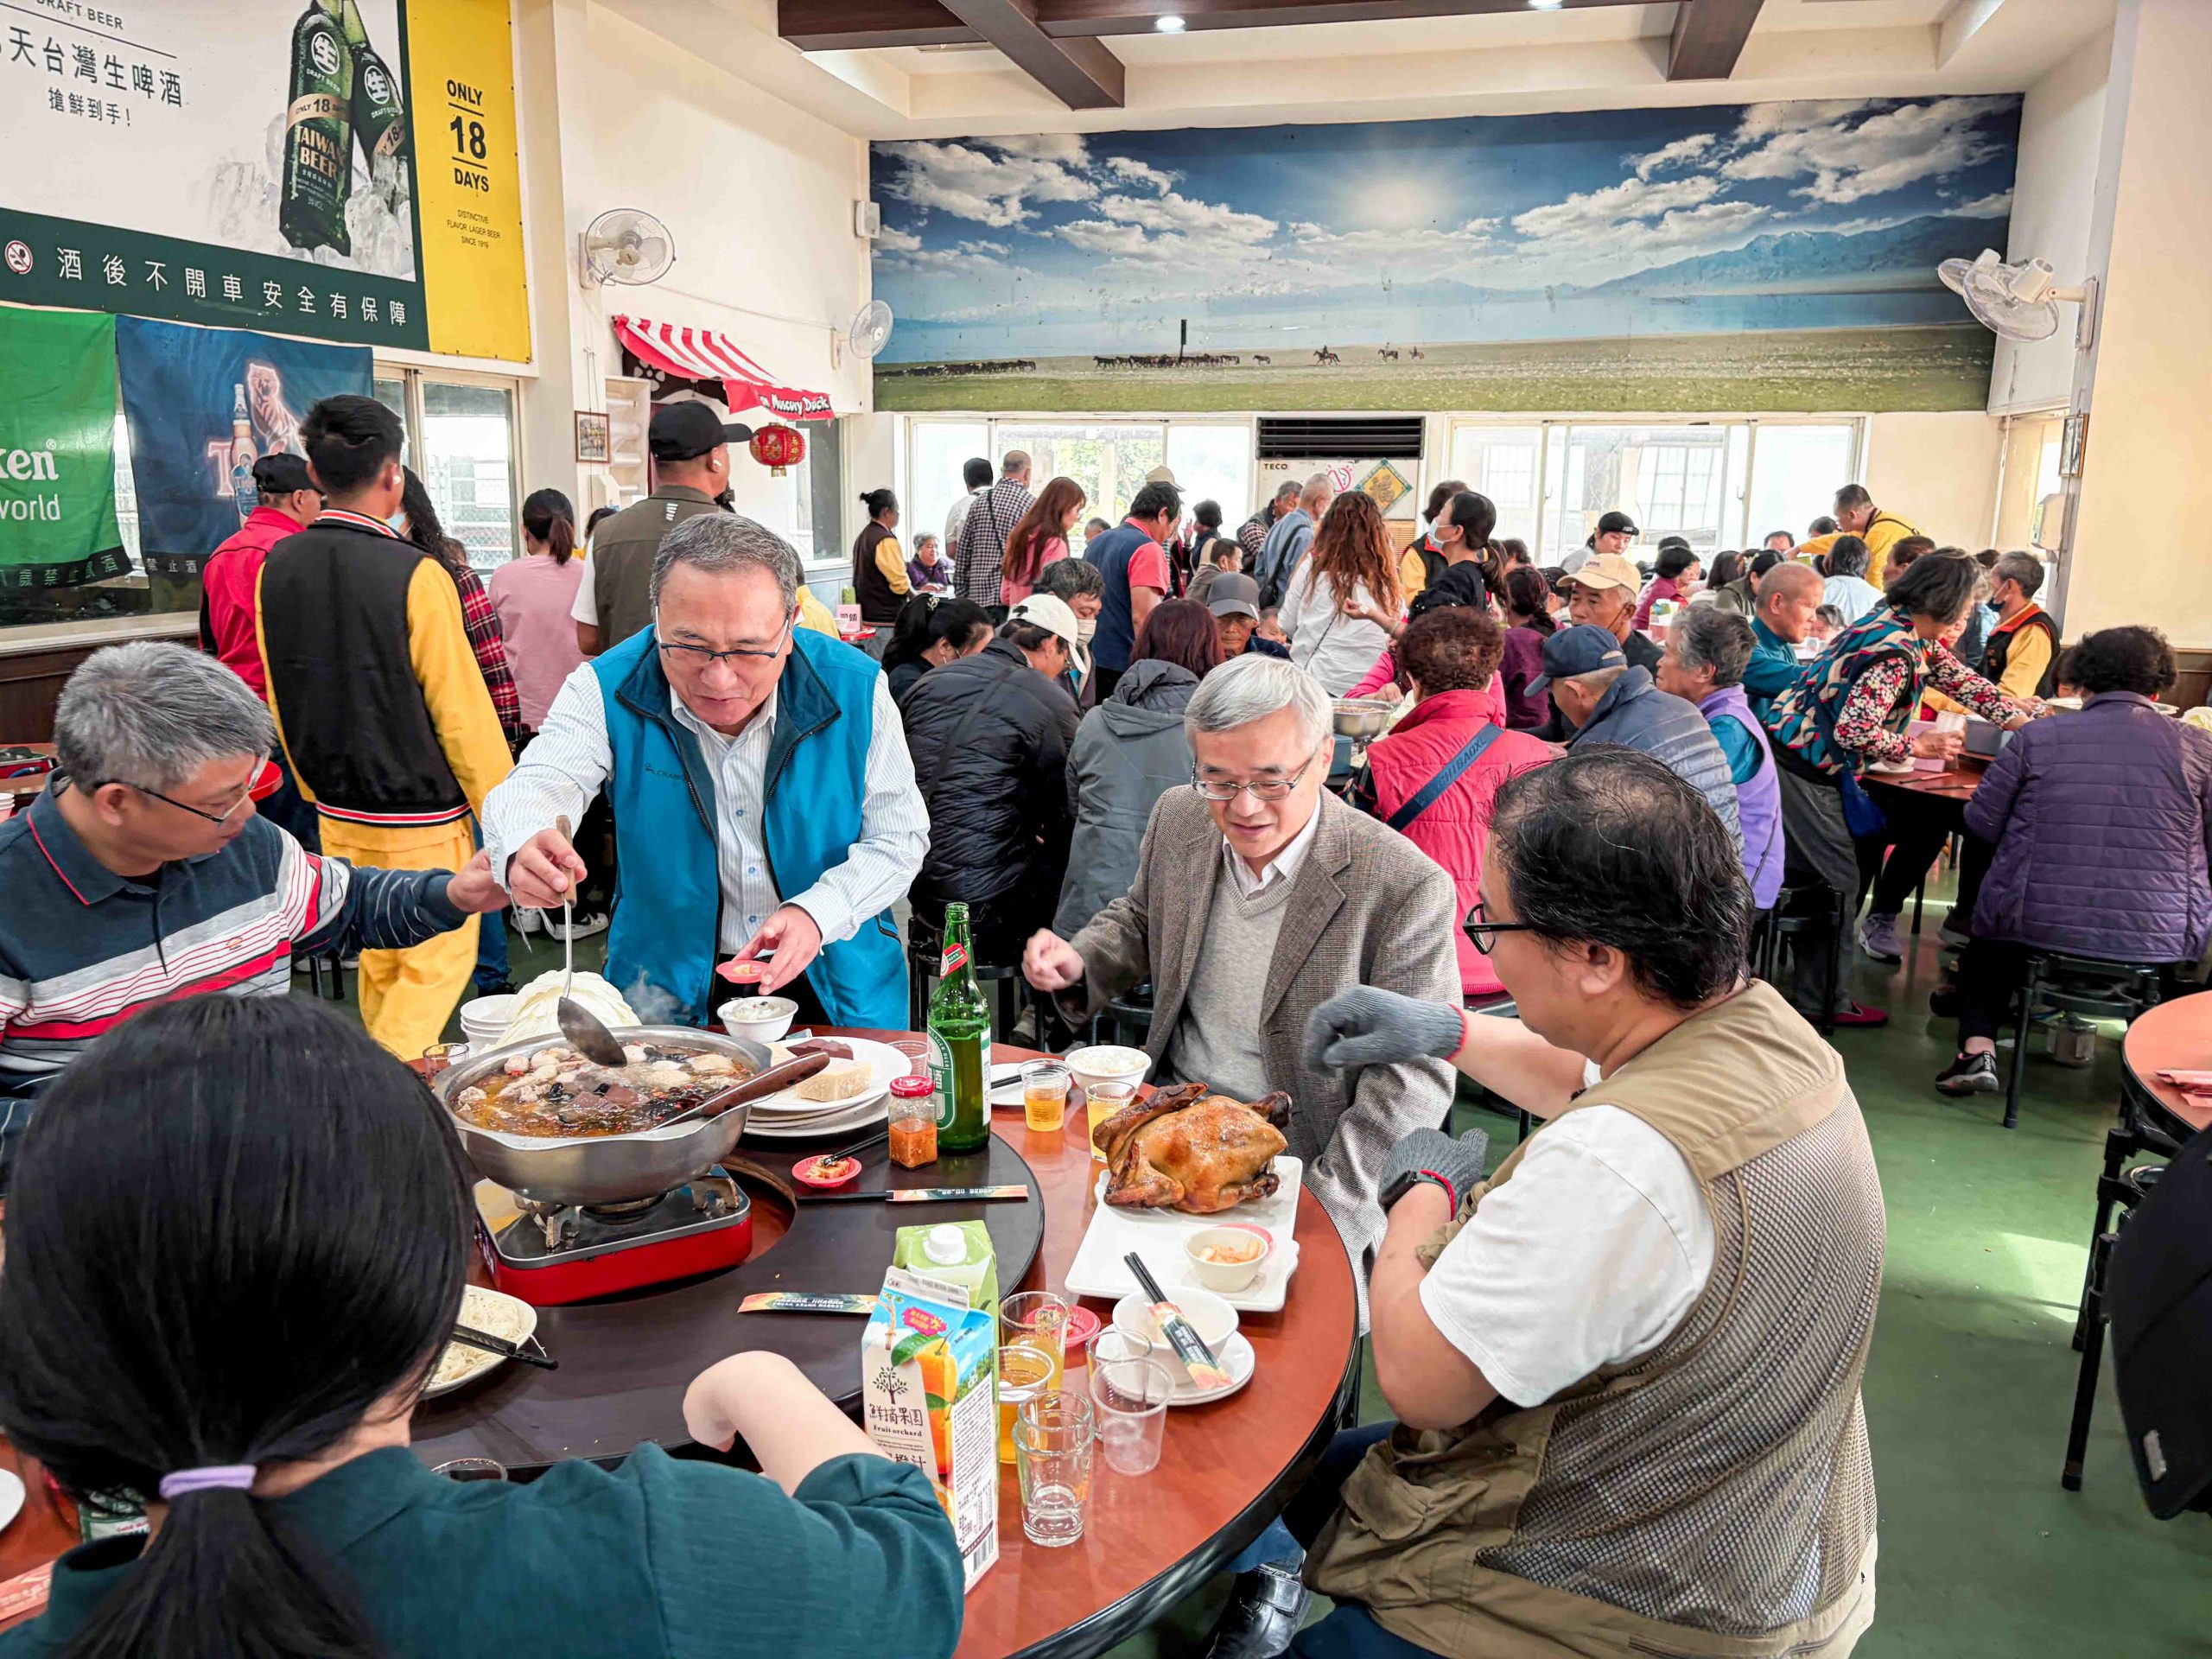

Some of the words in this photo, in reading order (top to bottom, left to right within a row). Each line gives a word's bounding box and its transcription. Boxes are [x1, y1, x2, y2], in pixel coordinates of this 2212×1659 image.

[87, 8, 124, 30] BEER
[447, 79, 483, 105] ONLY
[313, 99, 330, 112] 18
[450, 115, 486, 160] 18
[300, 146, 337, 180] BEER
[454, 168, 489, 193] DAYS
[57, 247, 407, 327] 酒後不開車安全有保障
[892, 1427, 922, 1437] orchard
